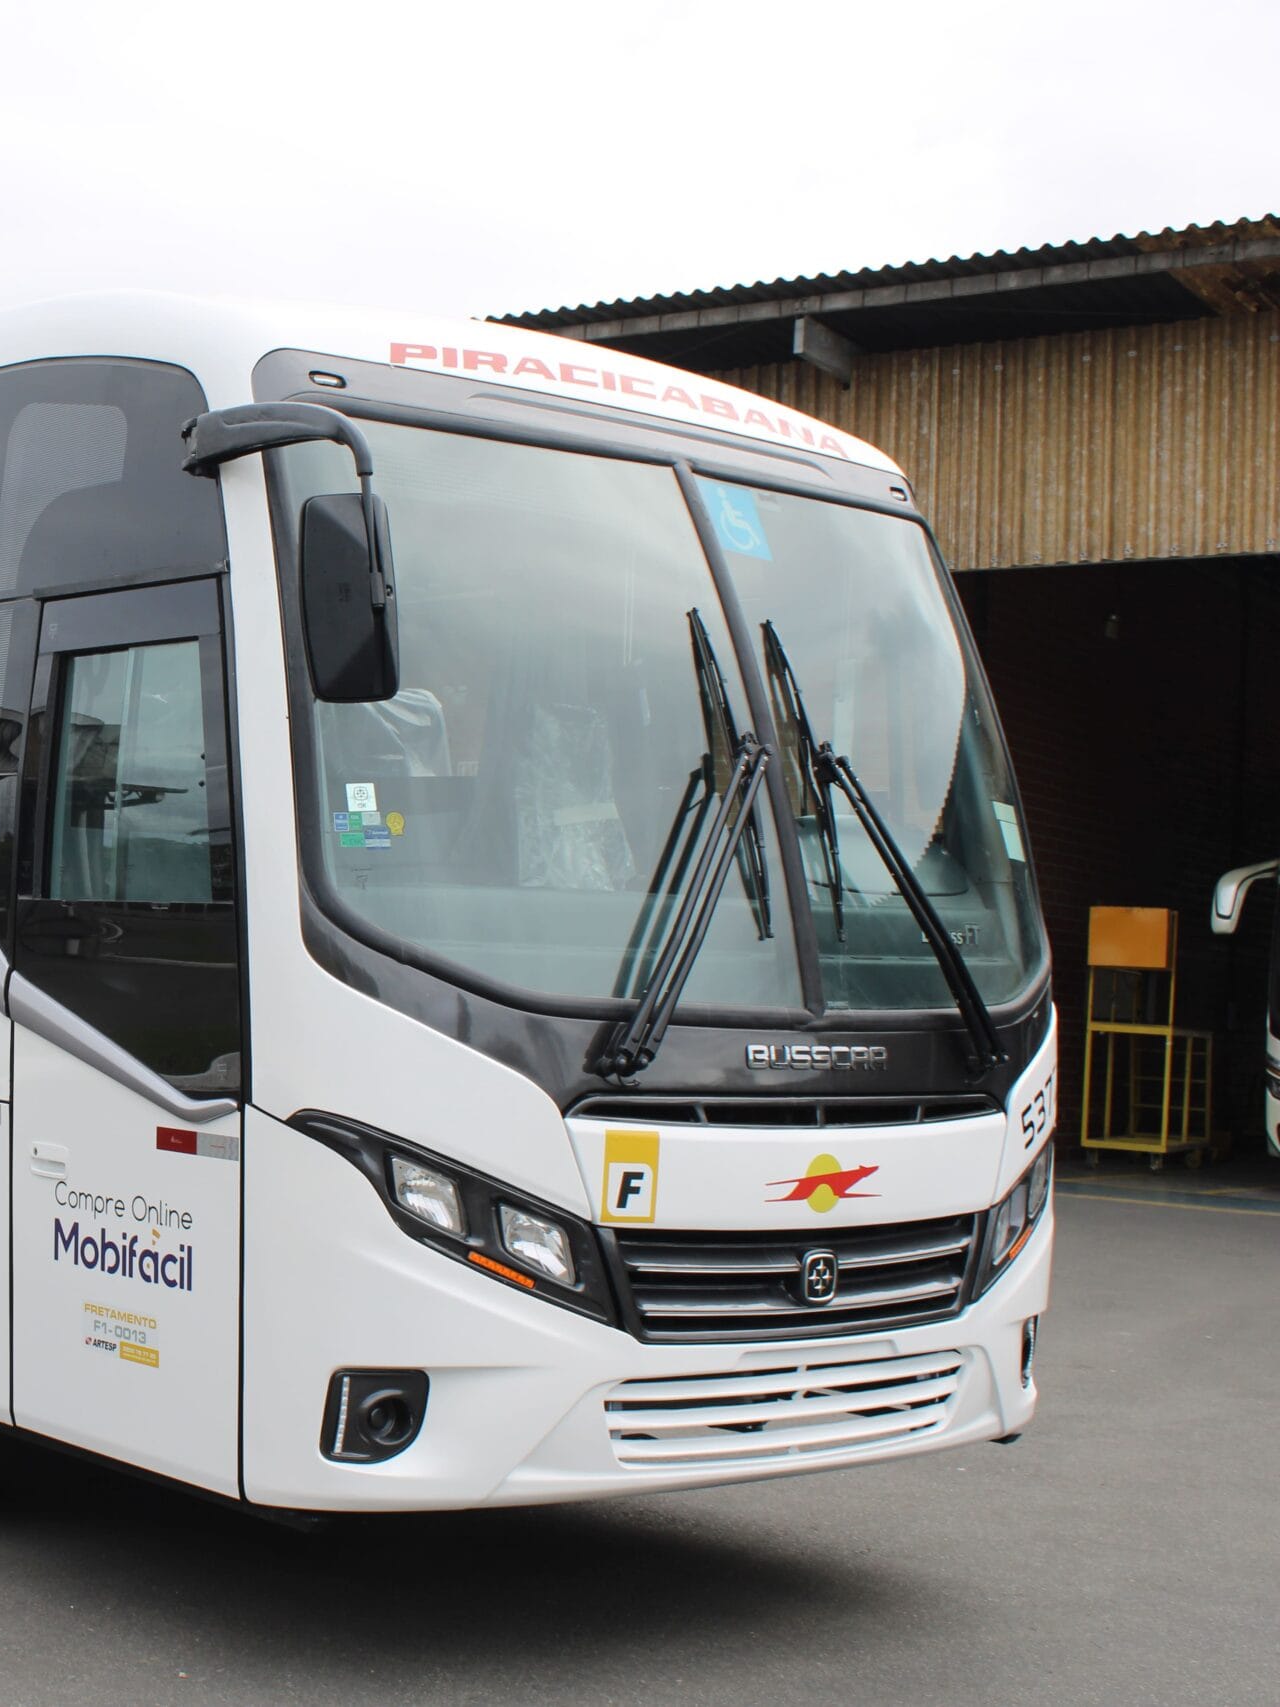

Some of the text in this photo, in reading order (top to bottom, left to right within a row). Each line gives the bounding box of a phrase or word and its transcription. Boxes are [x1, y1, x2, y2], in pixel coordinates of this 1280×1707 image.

[390, 342, 850, 459] PIRACICABANA
[746, 1043, 888, 1071] BUSSCAR
[1021, 1066, 1056, 1150] 537
[54, 1180, 193, 1230] Compre Online
[616, 1171, 645, 1209] F
[84, 1303, 157, 1330] FRETAMENTO
[93, 1319, 147, 1345] F1-0013
[92, 1338, 117, 1352] ARTESP
